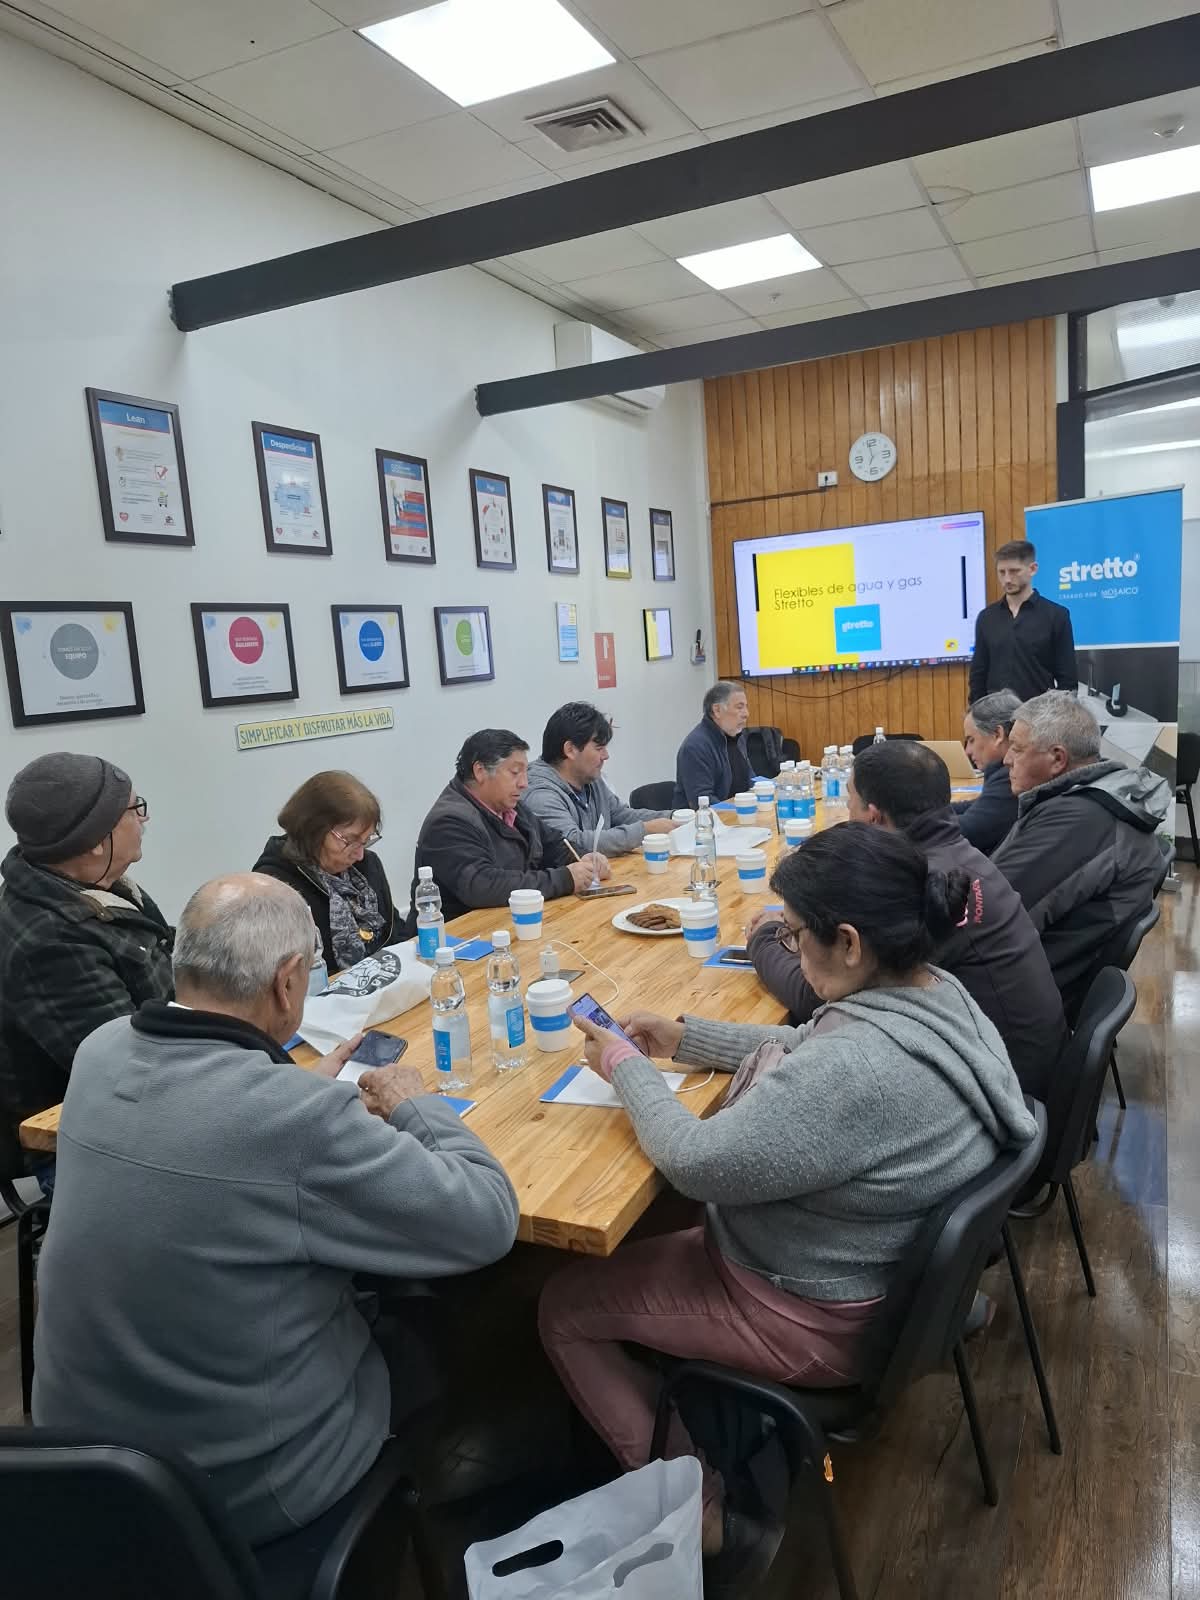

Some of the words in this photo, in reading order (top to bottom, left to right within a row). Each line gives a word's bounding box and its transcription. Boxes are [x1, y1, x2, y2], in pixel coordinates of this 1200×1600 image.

[126, 411, 146, 424] Lean
[866, 438, 877, 448] 12
[854, 455, 864, 465] 9
[881, 449, 891, 459] 3
[869, 466, 879, 475] 6
[1059, 556, 1138, 583] stretto
[774, 585, 823, 600] Flexibles
[827, 584, 844, 594] de
[848, 580, 883, 594] agua
[887, 579, 894, 589] y
[898, 576, 922, 590] gas
[774, 598, 814, 611] Stretto
[240, 725, 293, 745] SIMPLIFICAR
[295, 724, 301, 736] Y
[303, 718, 346, 736] DISFRUTAR
[347, 712, 363, 729] MÁS
[364, 716, 374, 727] LA
[376, 711, 392, 725] VIDA
